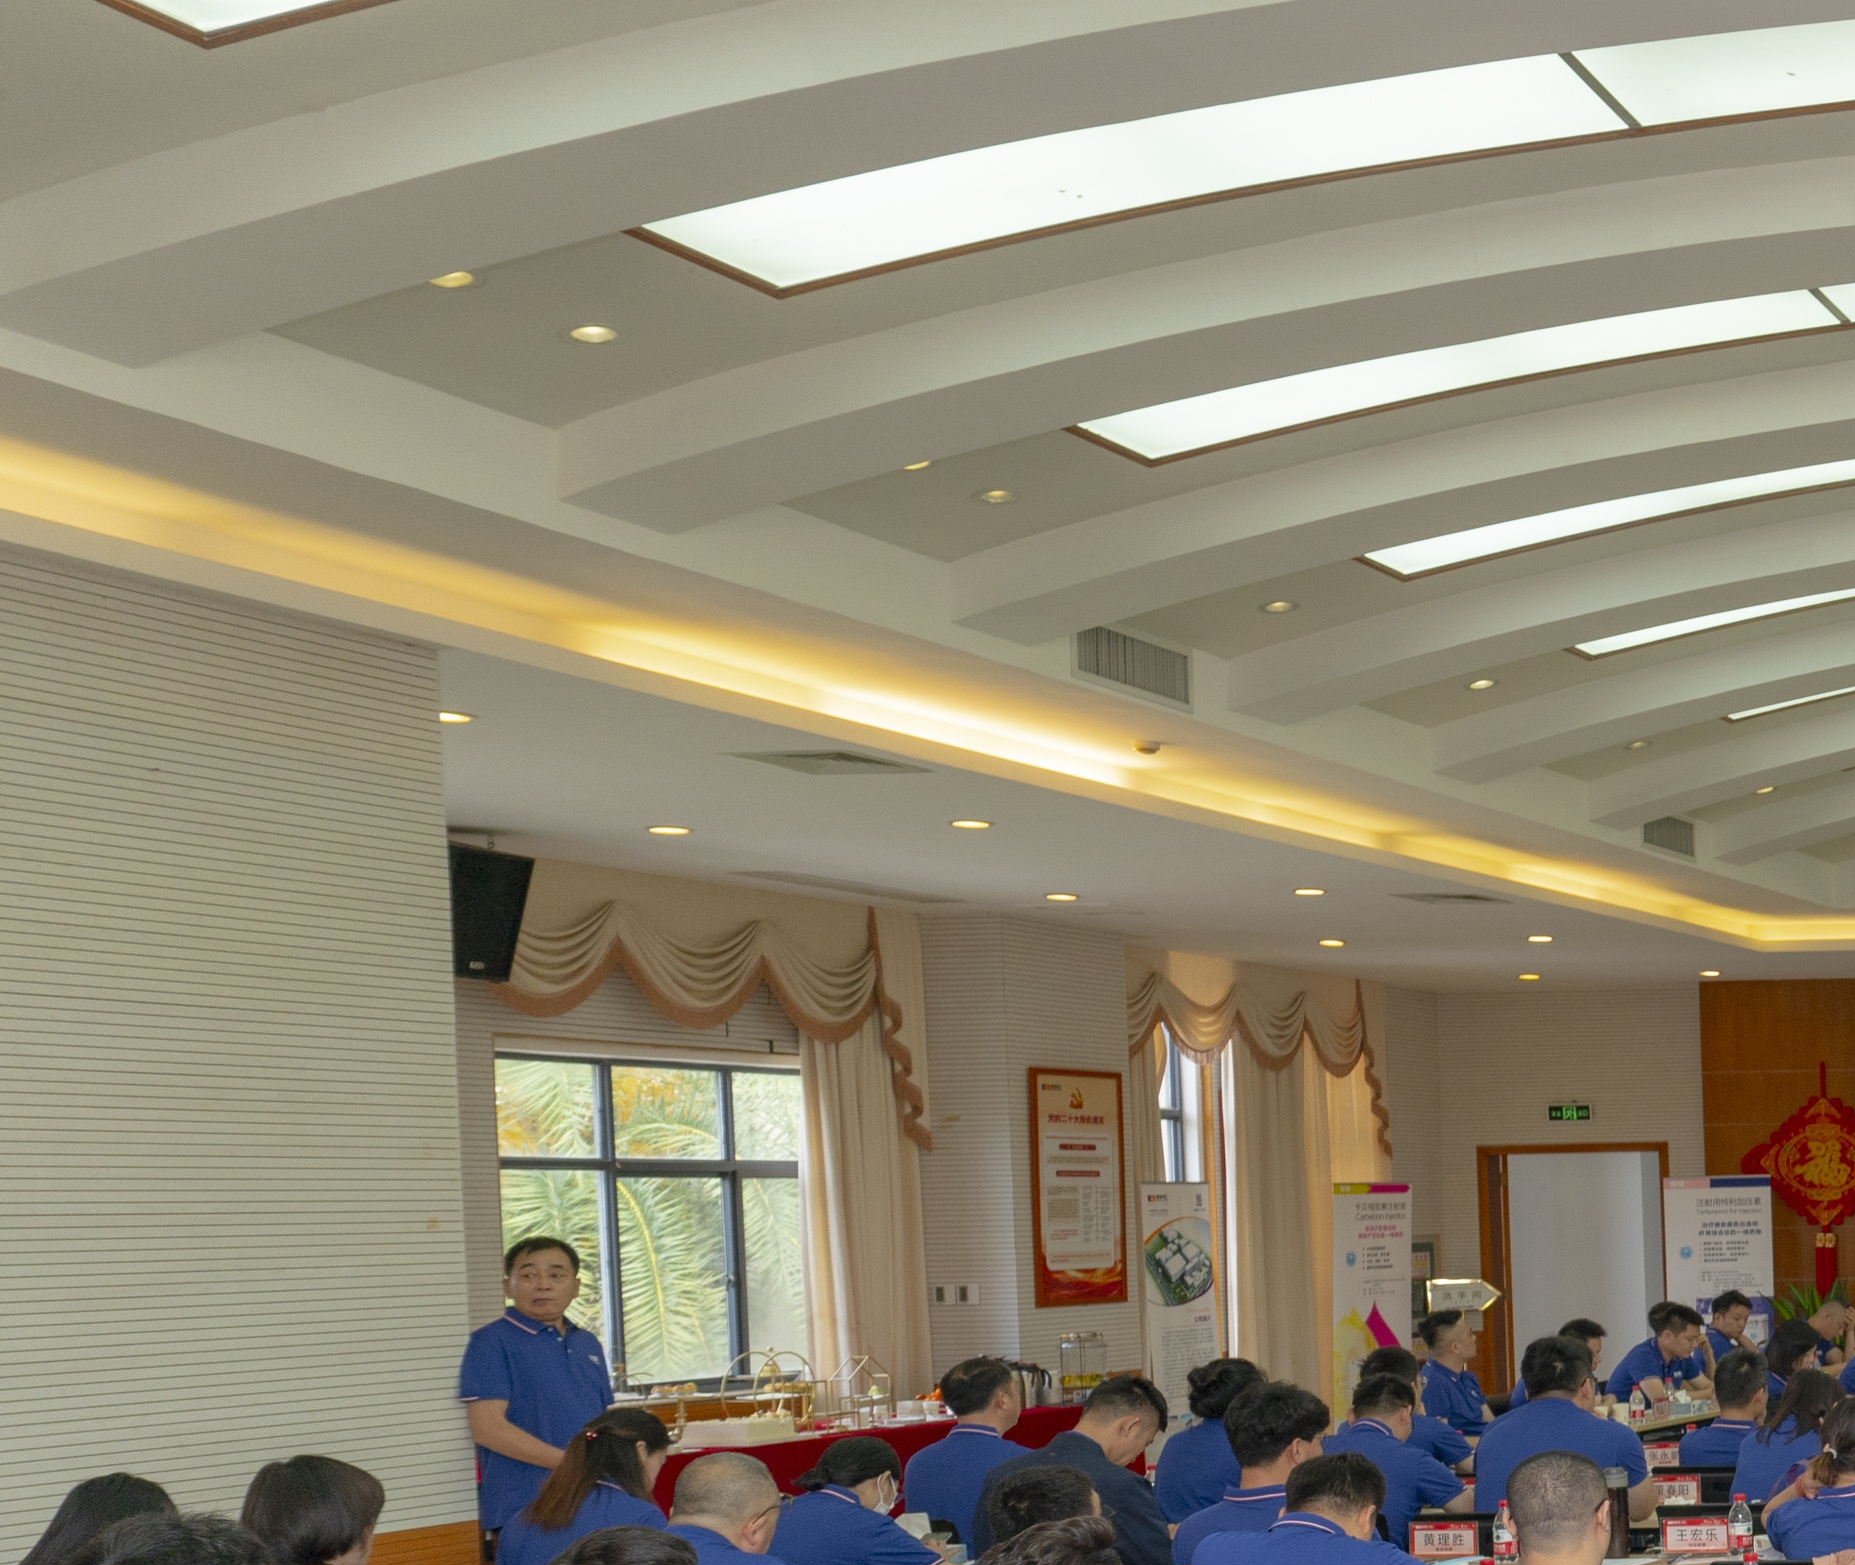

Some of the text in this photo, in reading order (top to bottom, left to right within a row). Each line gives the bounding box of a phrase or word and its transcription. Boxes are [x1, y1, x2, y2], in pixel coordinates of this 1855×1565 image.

[1442, 1291, 1482, 1301] 洗手间
[1423, 1533, 1465, 1547] 黄理胜
[1676, 1528, 1718, 1542] 王宏乐
